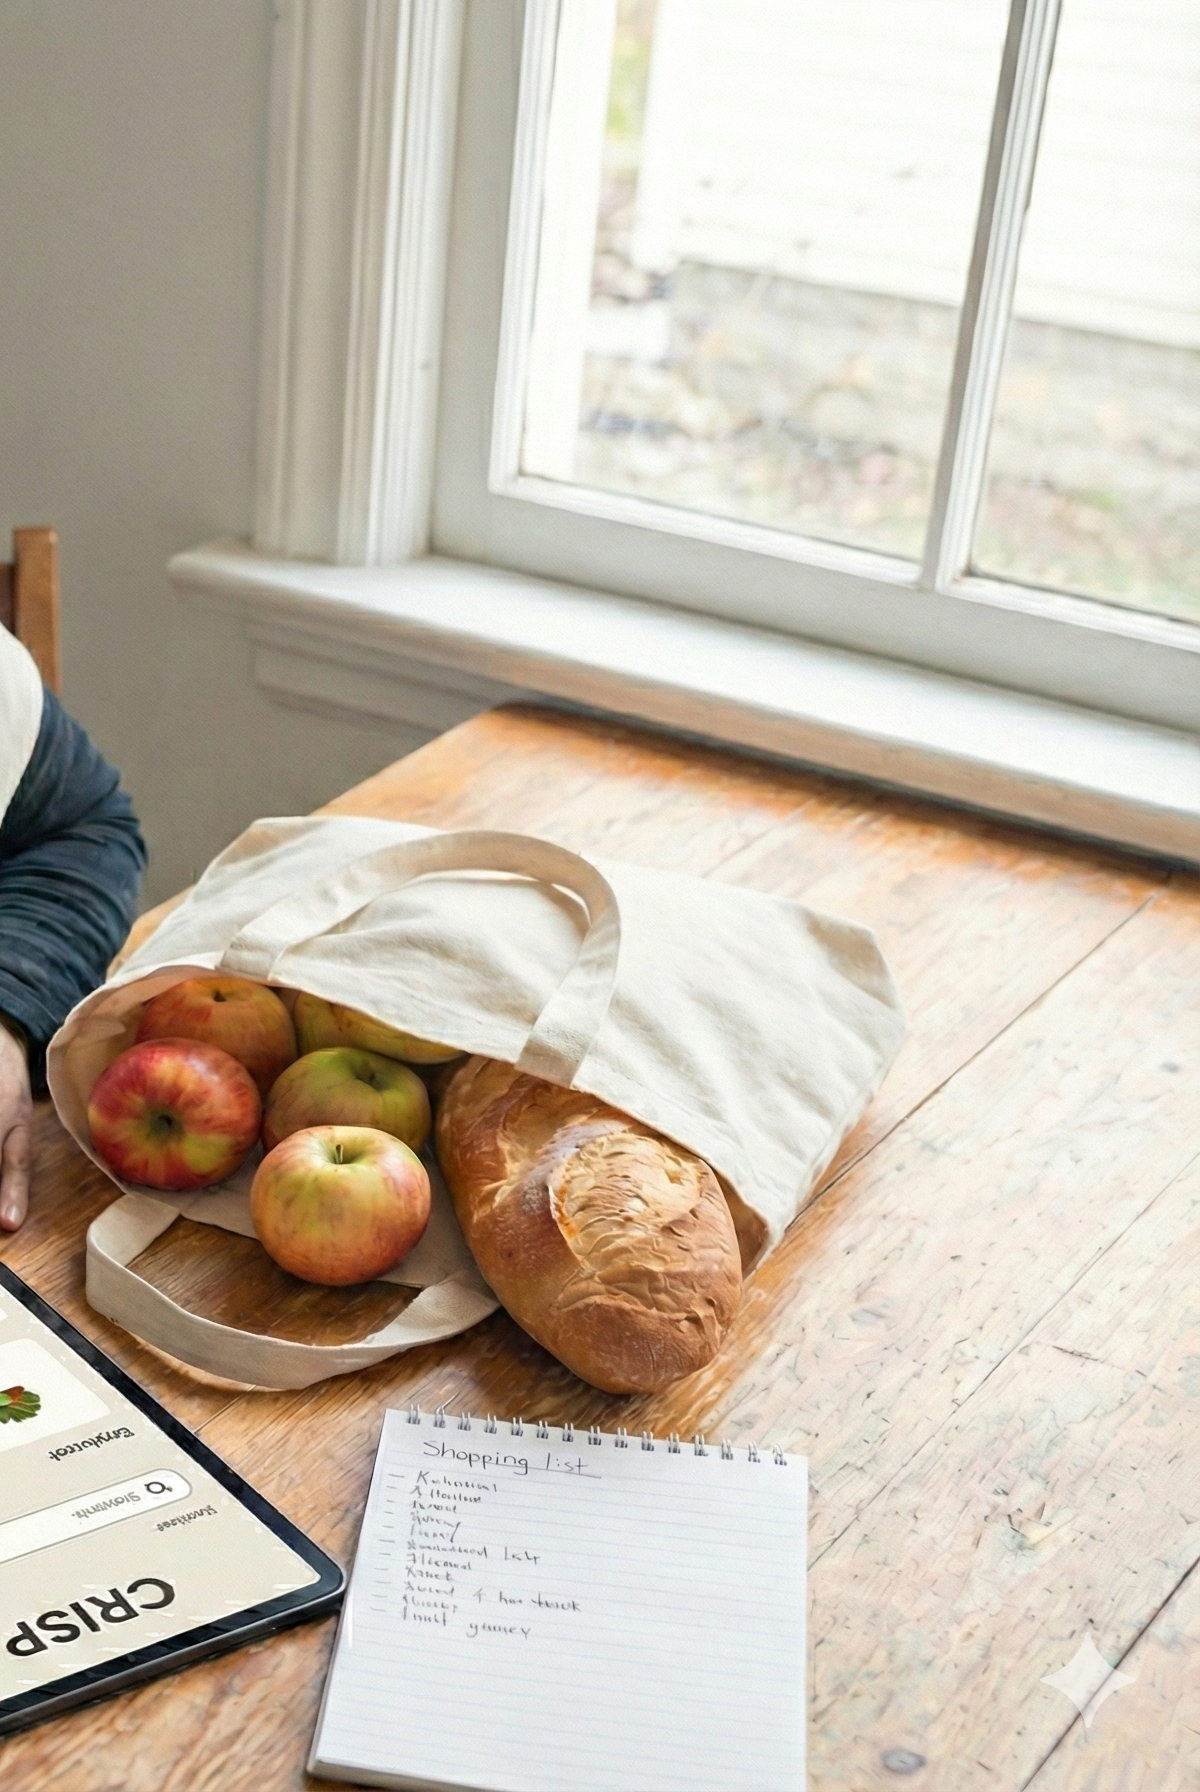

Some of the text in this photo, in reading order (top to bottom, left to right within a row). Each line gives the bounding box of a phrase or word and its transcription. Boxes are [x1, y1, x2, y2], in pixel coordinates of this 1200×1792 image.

[423, 1441, 589, 1475] Shopping list
[6, 1578, 175, 1656] CRISP
